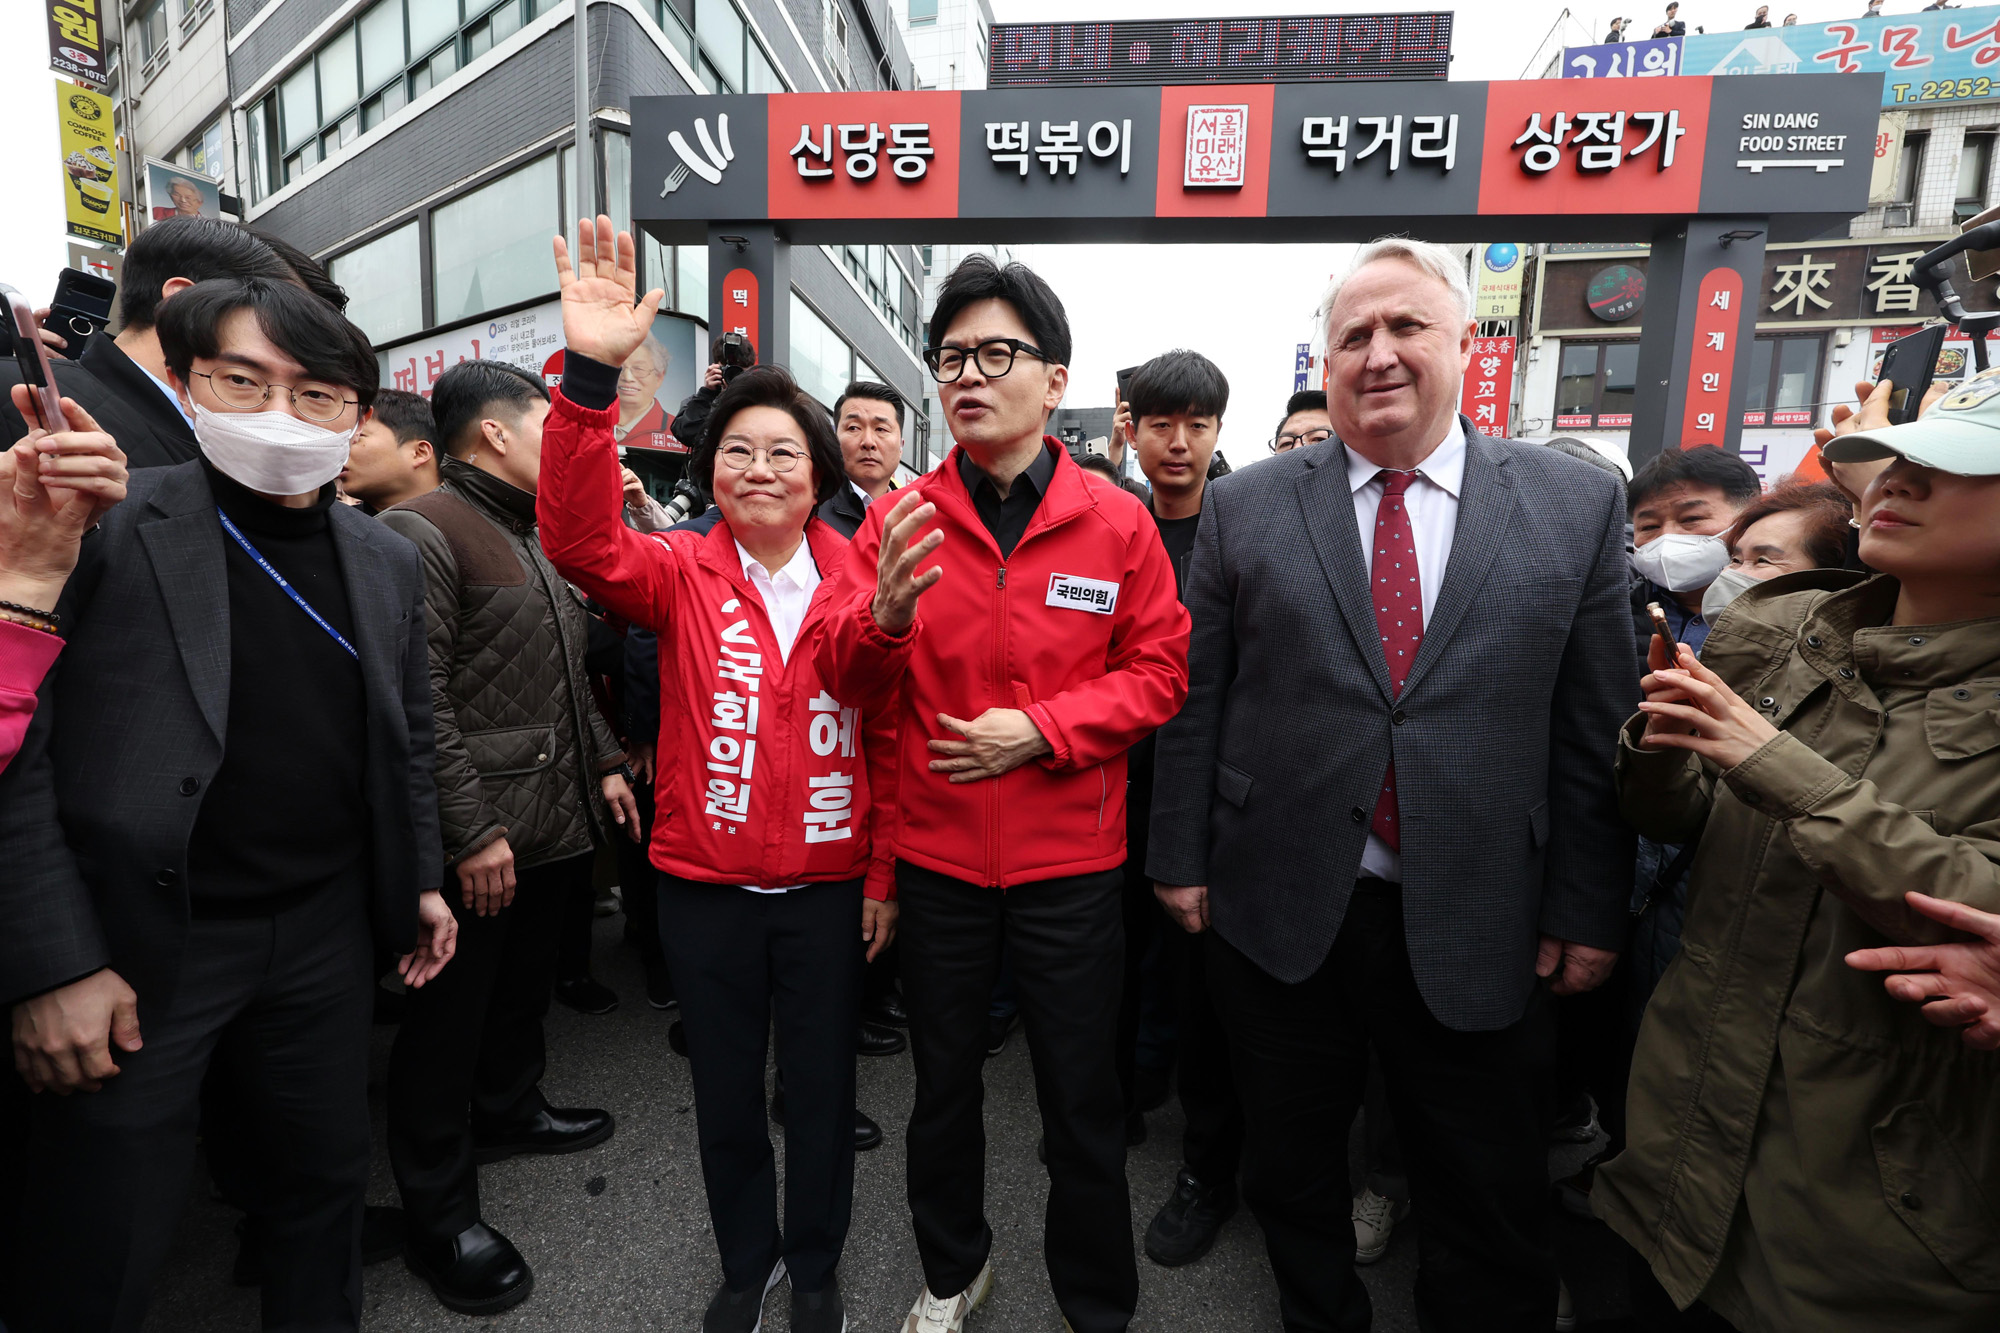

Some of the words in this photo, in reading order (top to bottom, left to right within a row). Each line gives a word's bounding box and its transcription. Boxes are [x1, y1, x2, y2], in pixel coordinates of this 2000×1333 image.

[52, 0, 99, 51] 원
[52, 57, 107, 80] 2238-1075
[67, 120, 107, 137] COMPOSE
[1196, 114, 1238, 136] 서울
[1742, 114, 1770, 130] SIN
[1774, 113, 1819, 129] DANG
[73, 129, 102, 142] COFFEE
[1196, 137, 1236, 155] 미래
[1302, 114, 1459, 173] 먹거리
[1515, 110, 1686, 172] 상점가
[1739, 136, 1784, 152] FOOD
[1787, 135, 1847, 152] STREET
[789, 122, 935, 182] 신당동
[985, 119, 1132, 176] 떡볶이
[1195, 156, 1236, 177] 유산
[73, 225, 117, 243] 컴포즈커피
[81, 255, 114, 280] kt
[1491, 305, 1505, 314] B1
[497, 322, 508, 334] SBS
[1695, 291, 1731, 432] 세계인의
[1474, 356, 1502, 424] 양꼬치
[1056, 584, 1109, 606] 국민의힘
